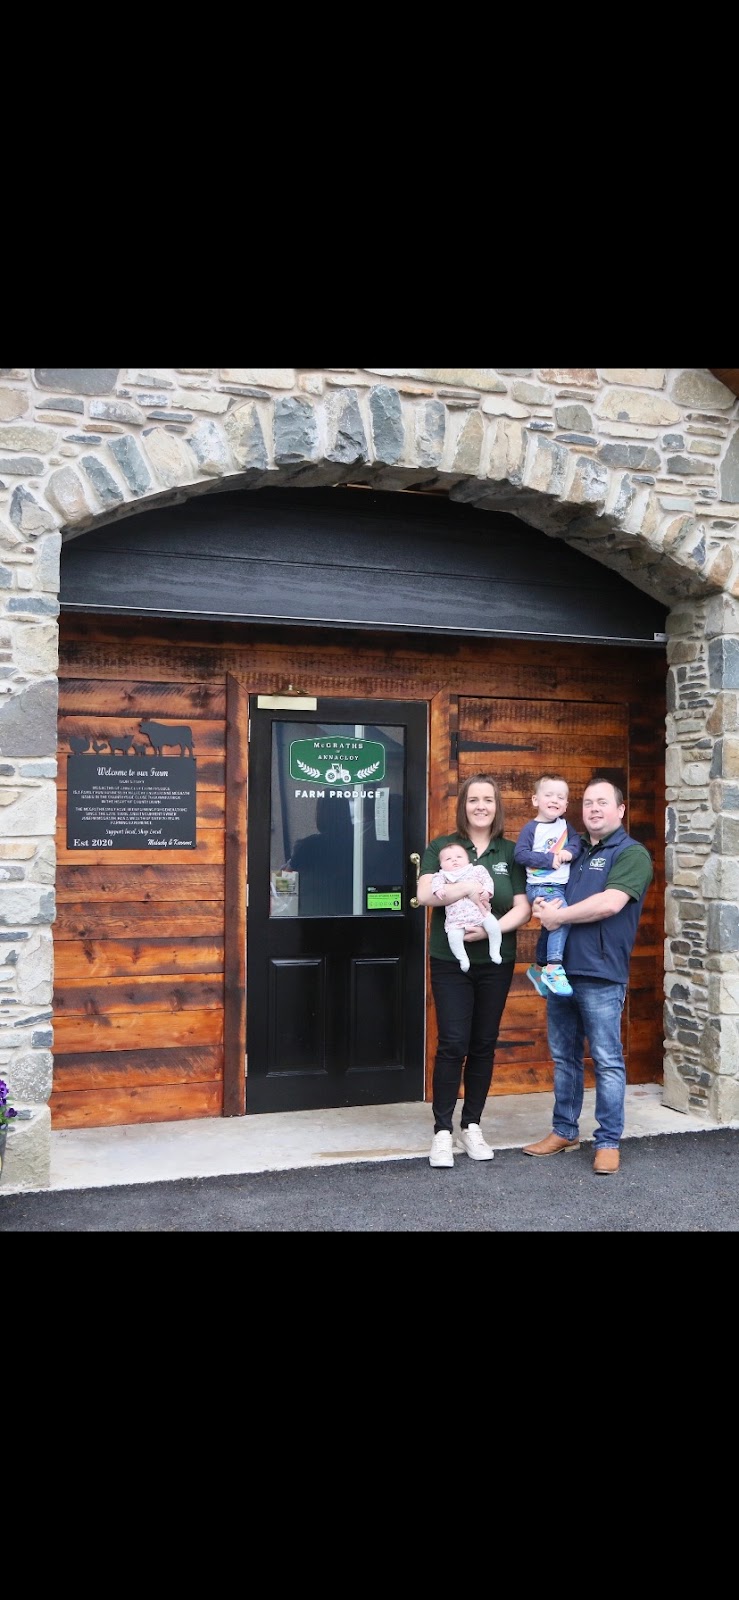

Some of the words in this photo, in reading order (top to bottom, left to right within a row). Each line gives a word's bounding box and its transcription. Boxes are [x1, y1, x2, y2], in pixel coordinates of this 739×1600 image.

[96, 766, 128, 777] Welcome
[128, 768, 136, 777] to
[150, 767, 169, 777] Farm
[294, 790, 325, 799] FARM
[329, 790, 381, 799] PRODUCE
[105, 828, 124, 837] Support
[73, 839, 89, 847] Est
[91, 839, 113, 847] 2020
